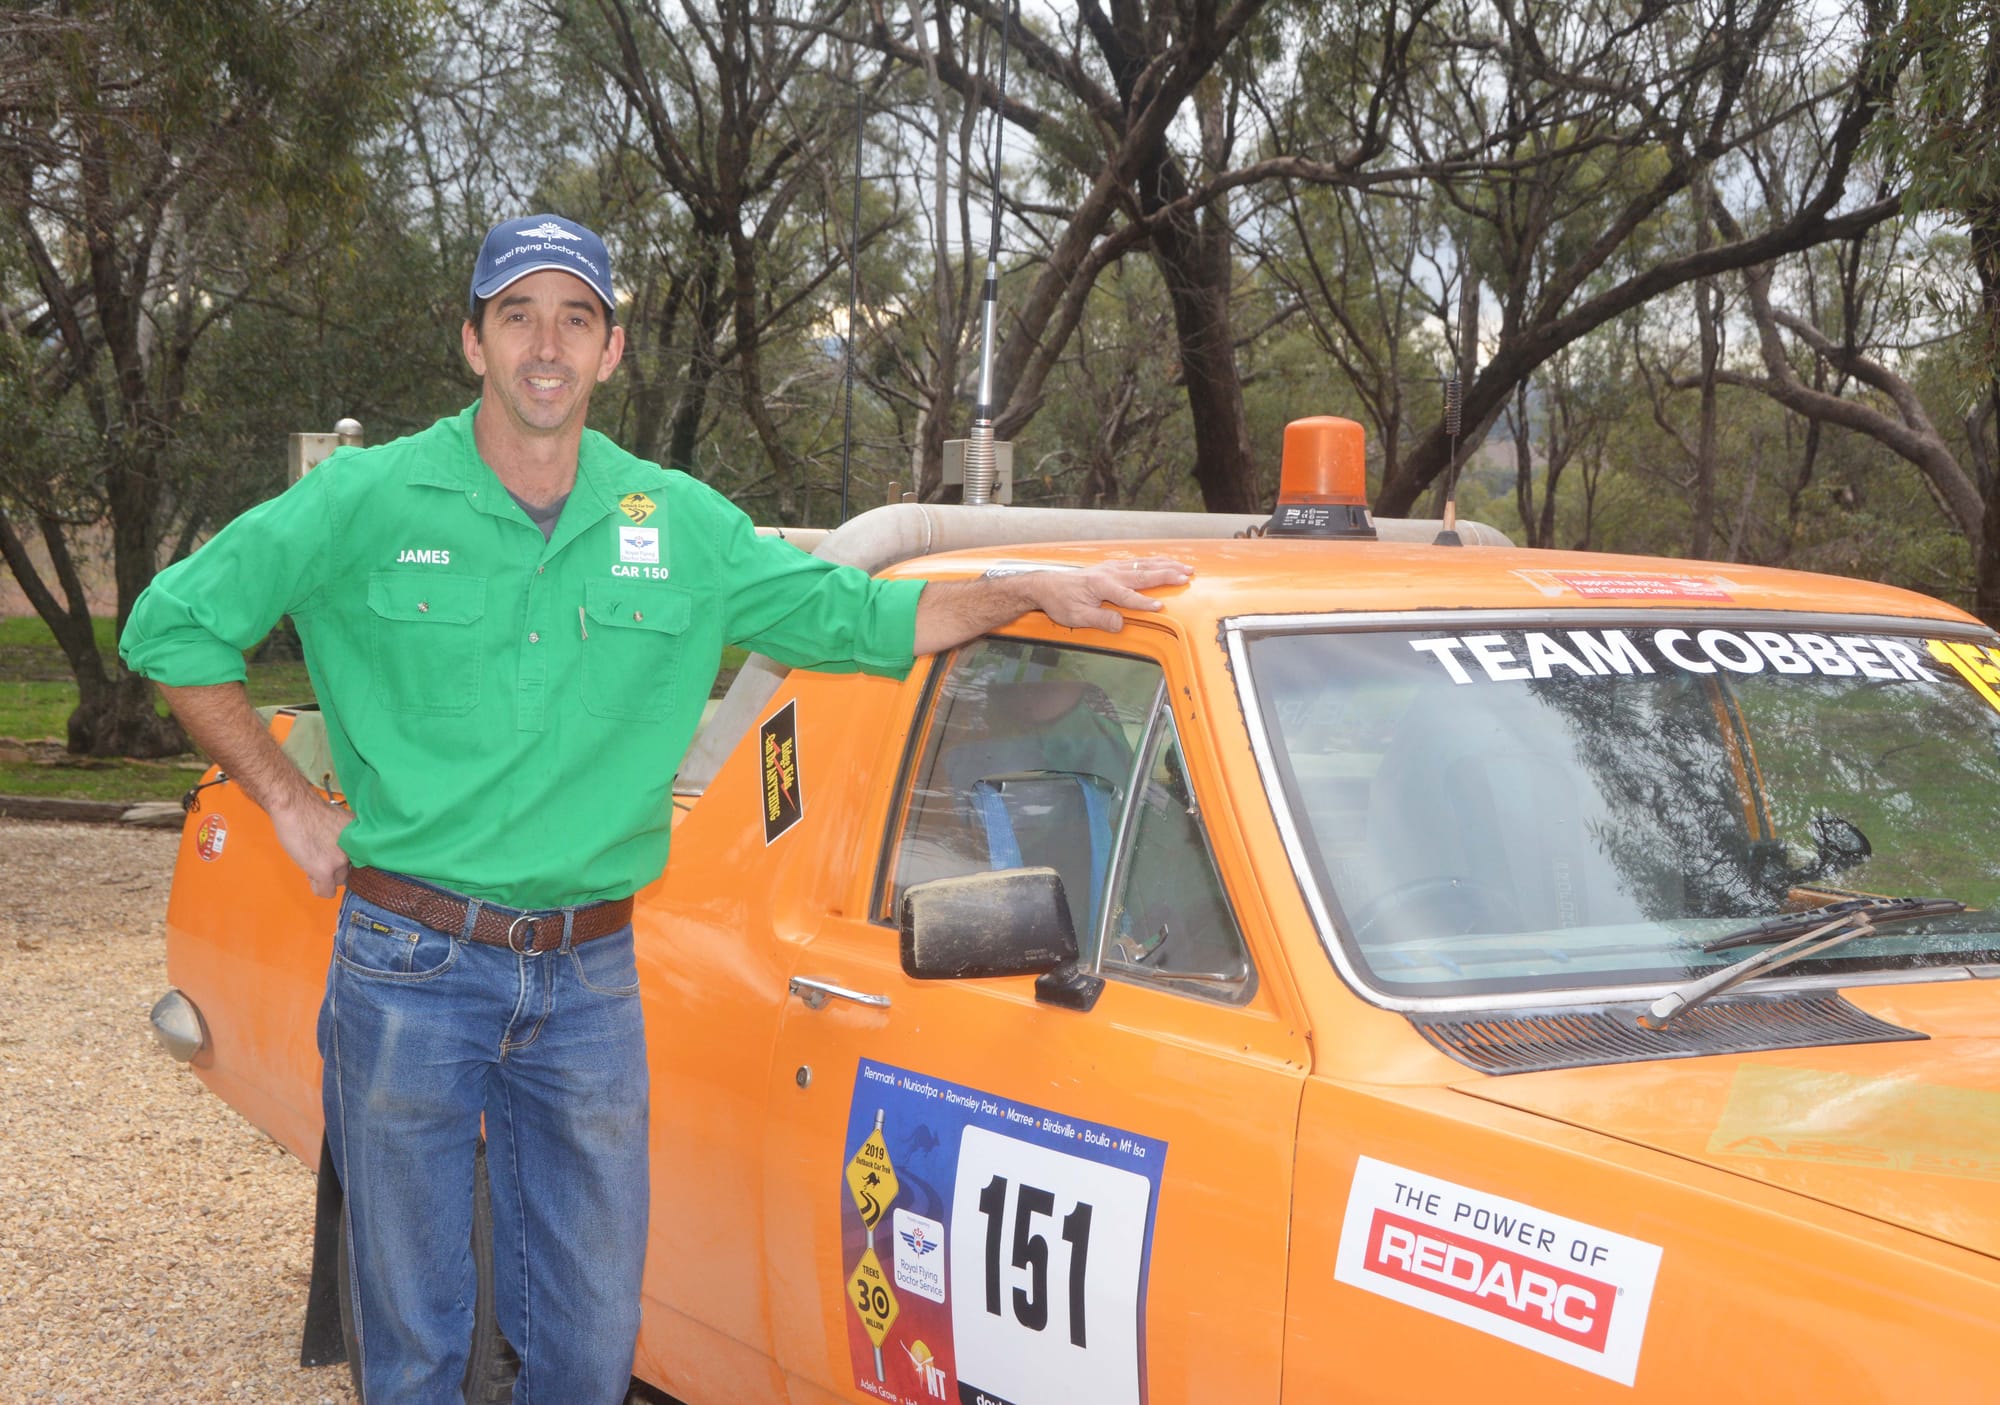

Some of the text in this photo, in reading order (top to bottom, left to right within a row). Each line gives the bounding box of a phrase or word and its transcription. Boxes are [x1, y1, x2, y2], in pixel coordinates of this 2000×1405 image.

[495, 249, 514, 266] Royal
[515, 243, 542, 255] Flying
[543, 242, 576, 256] Doctor
[396, 549, 450, 564] JAMES
[611, 564, 669, 580] CAR 150
[1408, 630, 1656, 684] TEAM
[1654, 628, 1941, 682] COBBER
[766, 766, 781, 821] ANYTHING
[864, 1066, 1146, 1158] Renmark Nuriootpa Rawnsley Park Marree Birdsville Boulia Mt Isa
[865, 1143, 885, 1160] 2019
[874, 1162, 882, 1171] Car
[1394, 1182, 1609, 1267] THE POWER OF
[863, 1265, 880, 1280] TREKS
[901, 1258, 938, 1284] Royal Flying
[979, 1174, 1093, 1349] 151
[897, 1270, 943, 1297] Doctor Service
[1377, 1223, 1597, 1334] REDARC
[857, 1279, 890, 1320] 30
[866, 1316, 884, 1332] MILLION
[878, 1386, 897, 1402] Grove
[925, 1364, 946, 1401] NT
